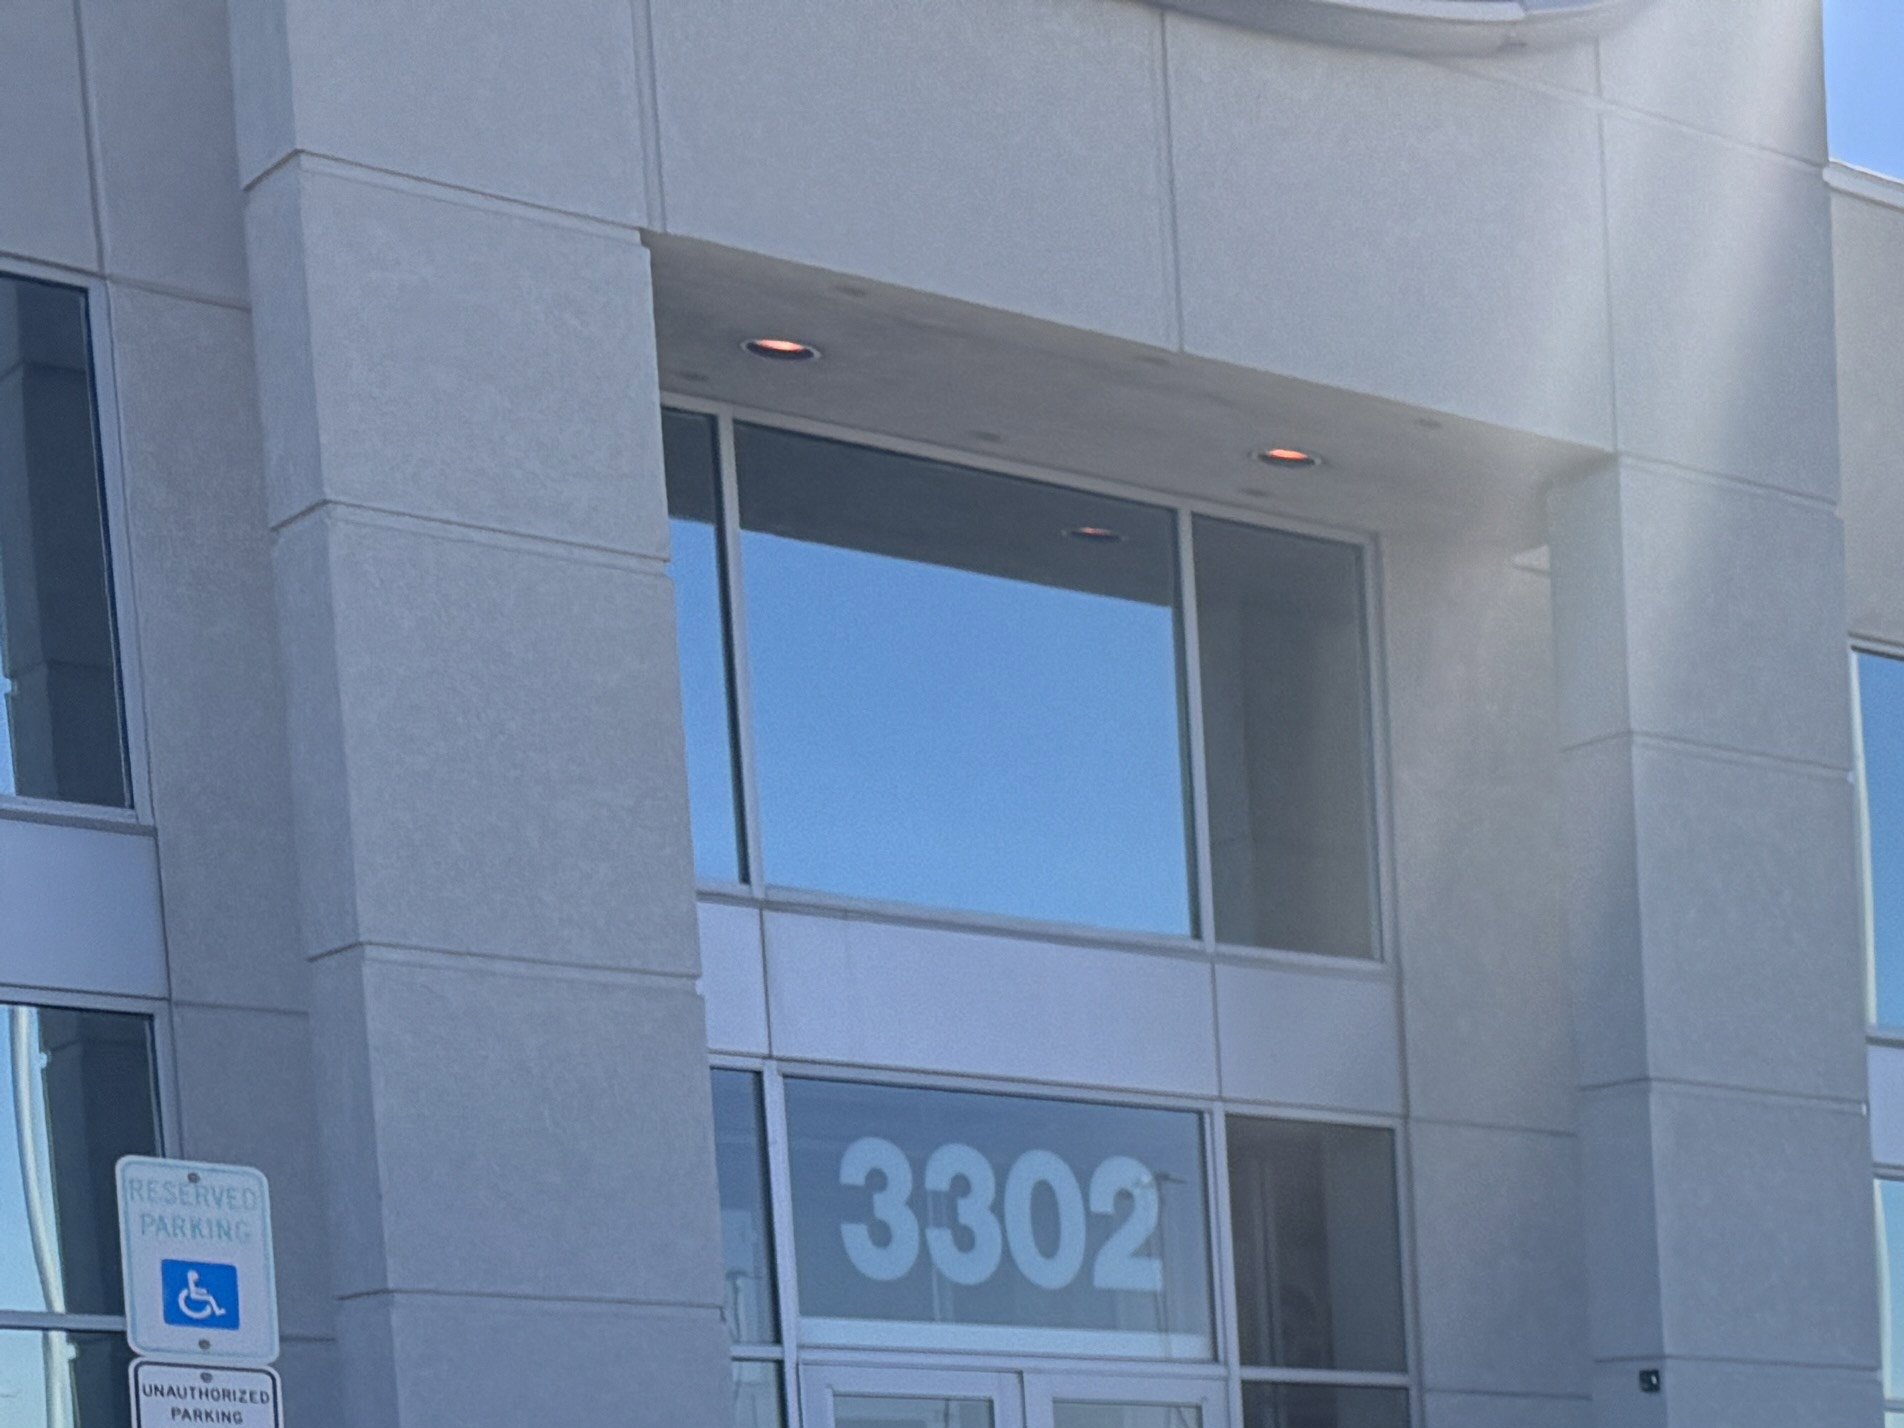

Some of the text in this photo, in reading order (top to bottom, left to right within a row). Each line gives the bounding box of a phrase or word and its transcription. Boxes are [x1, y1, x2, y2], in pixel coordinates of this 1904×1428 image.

[129, 1179, 258, 1211] RESERVED
[140, 1213, 251, 1243] PARKING
[840, 1137, 1162, 1291] 3302
[142, 1383, 270, 1405] UNAUTHORIZED
[170, 1406, 244, 1425] PARKING
